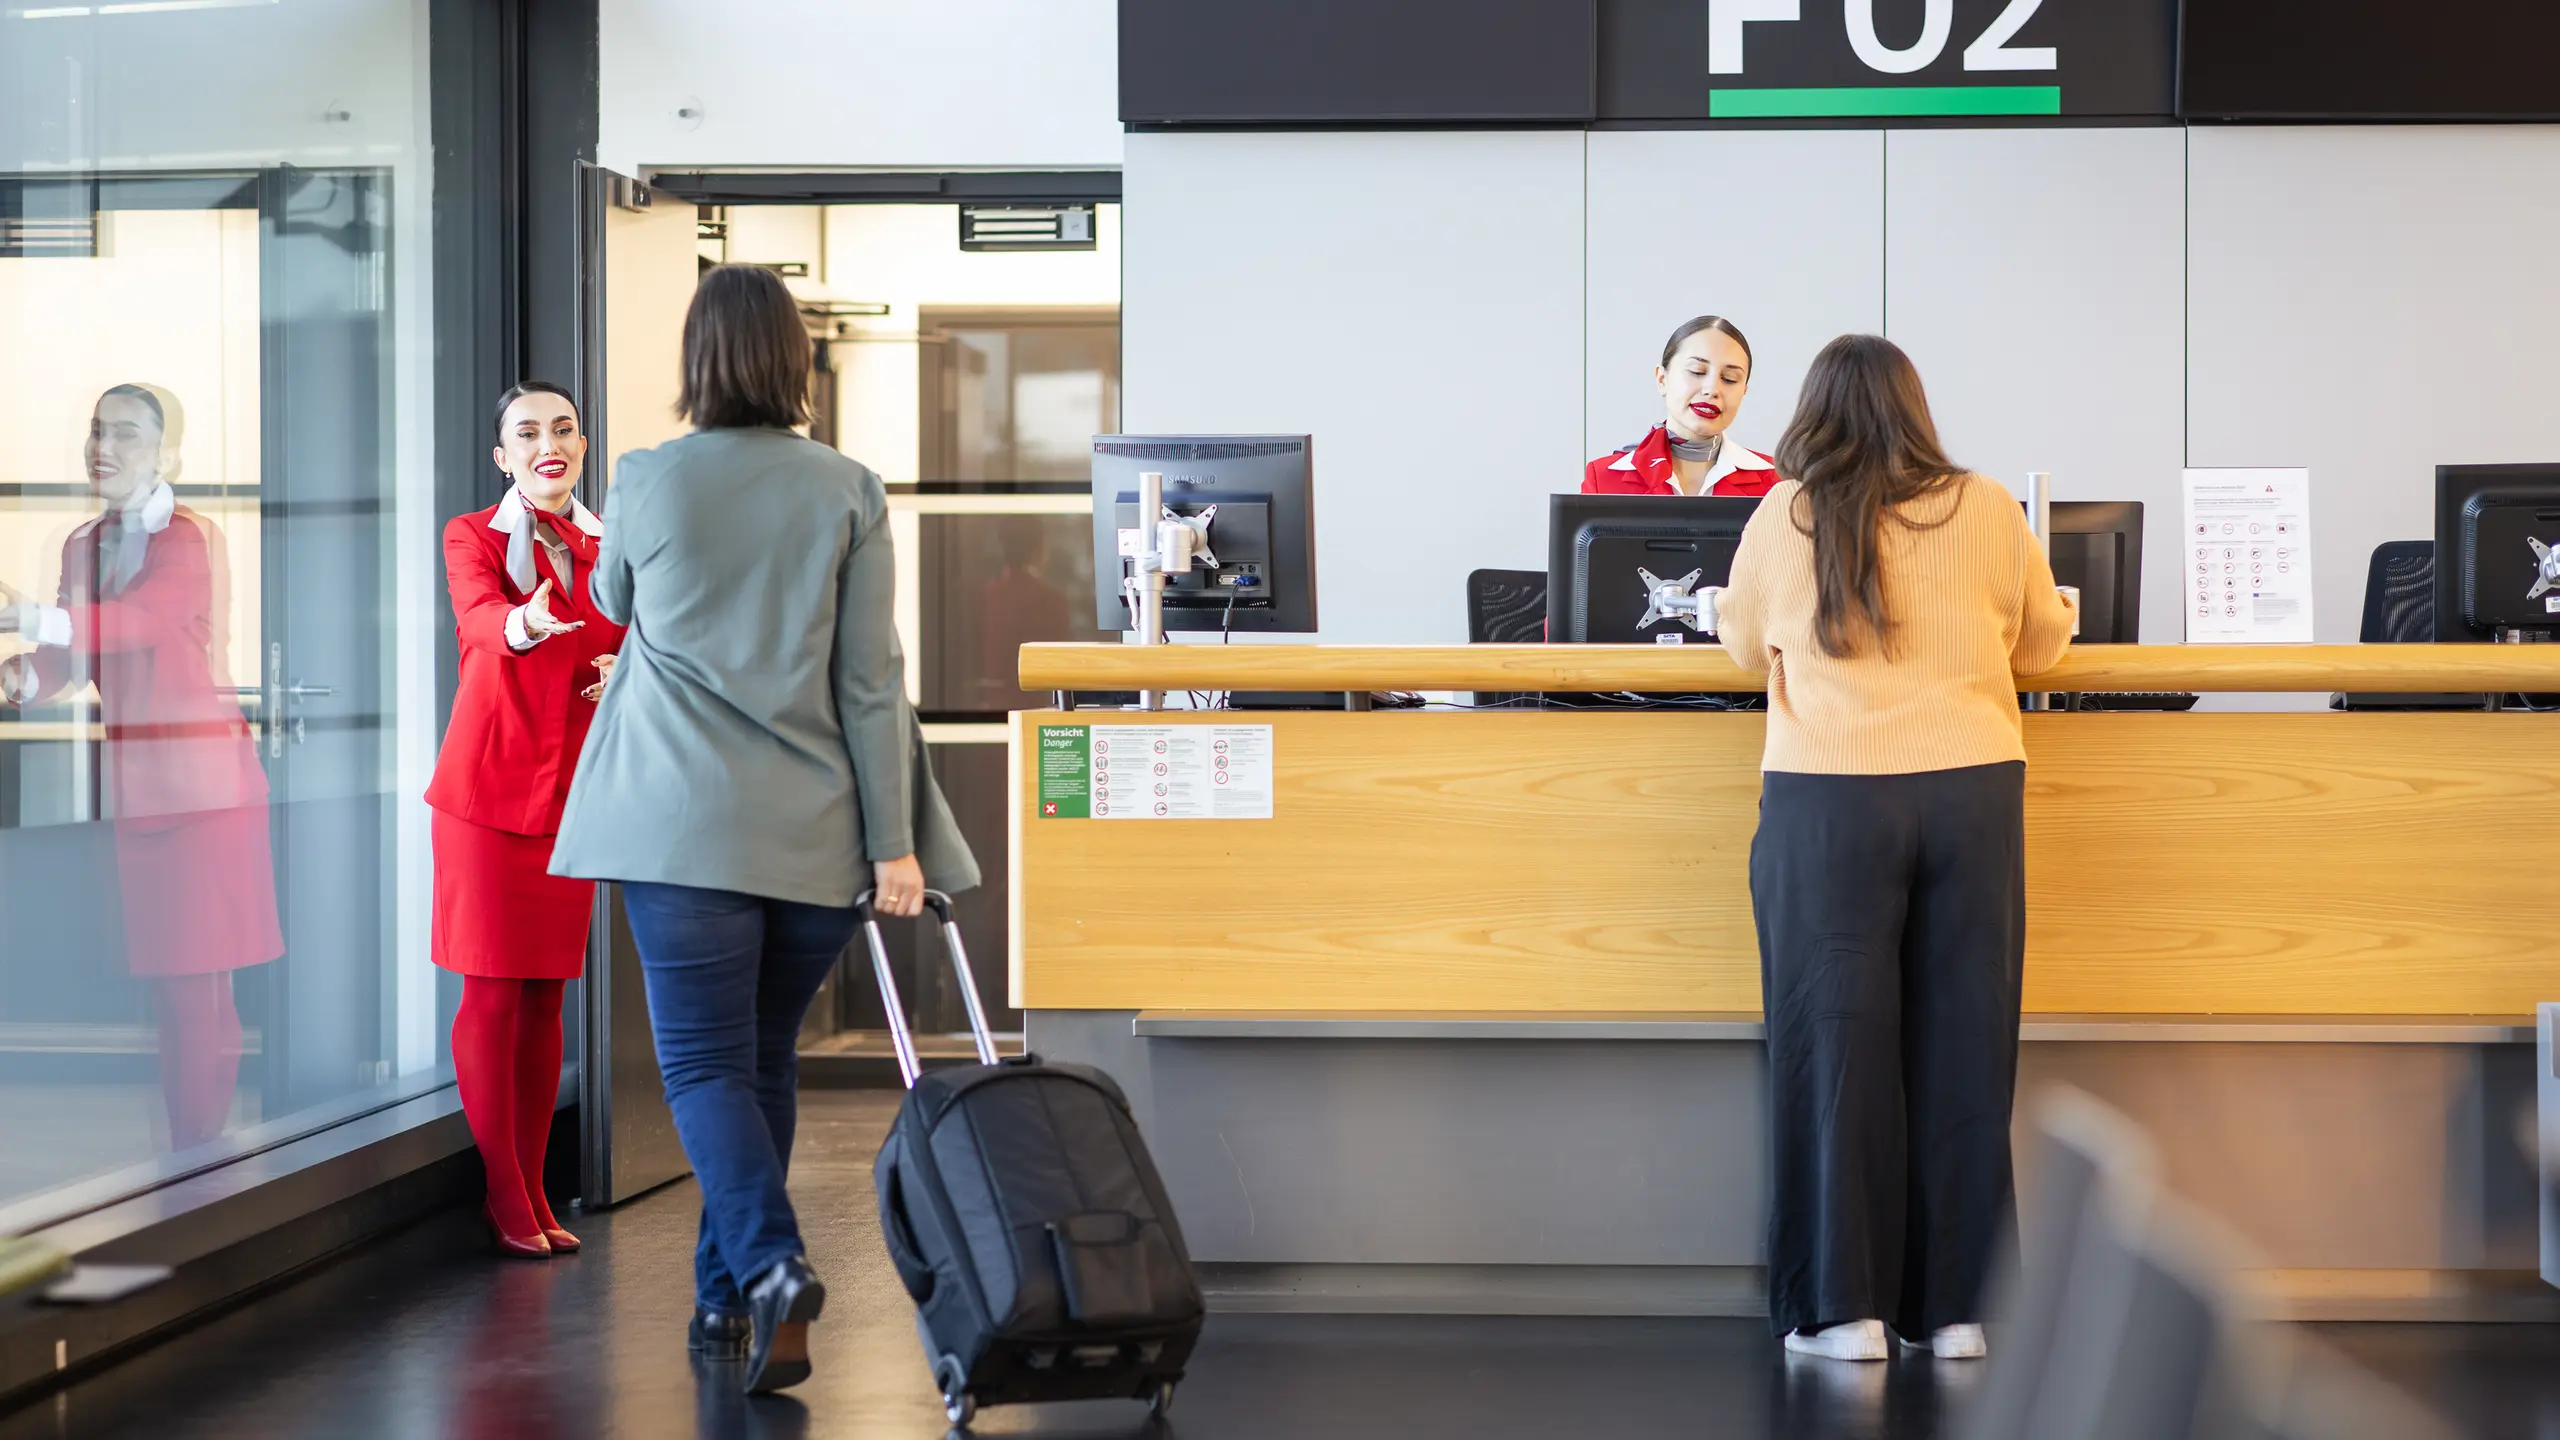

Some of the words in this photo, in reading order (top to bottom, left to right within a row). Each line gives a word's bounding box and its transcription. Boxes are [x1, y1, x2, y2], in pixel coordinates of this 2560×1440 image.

[1168, 475, 1216, 484] SAMSUNG
[1043, 728, 1084, 737] Vorsicht
[1043, 739, 1073, 748] Danger
